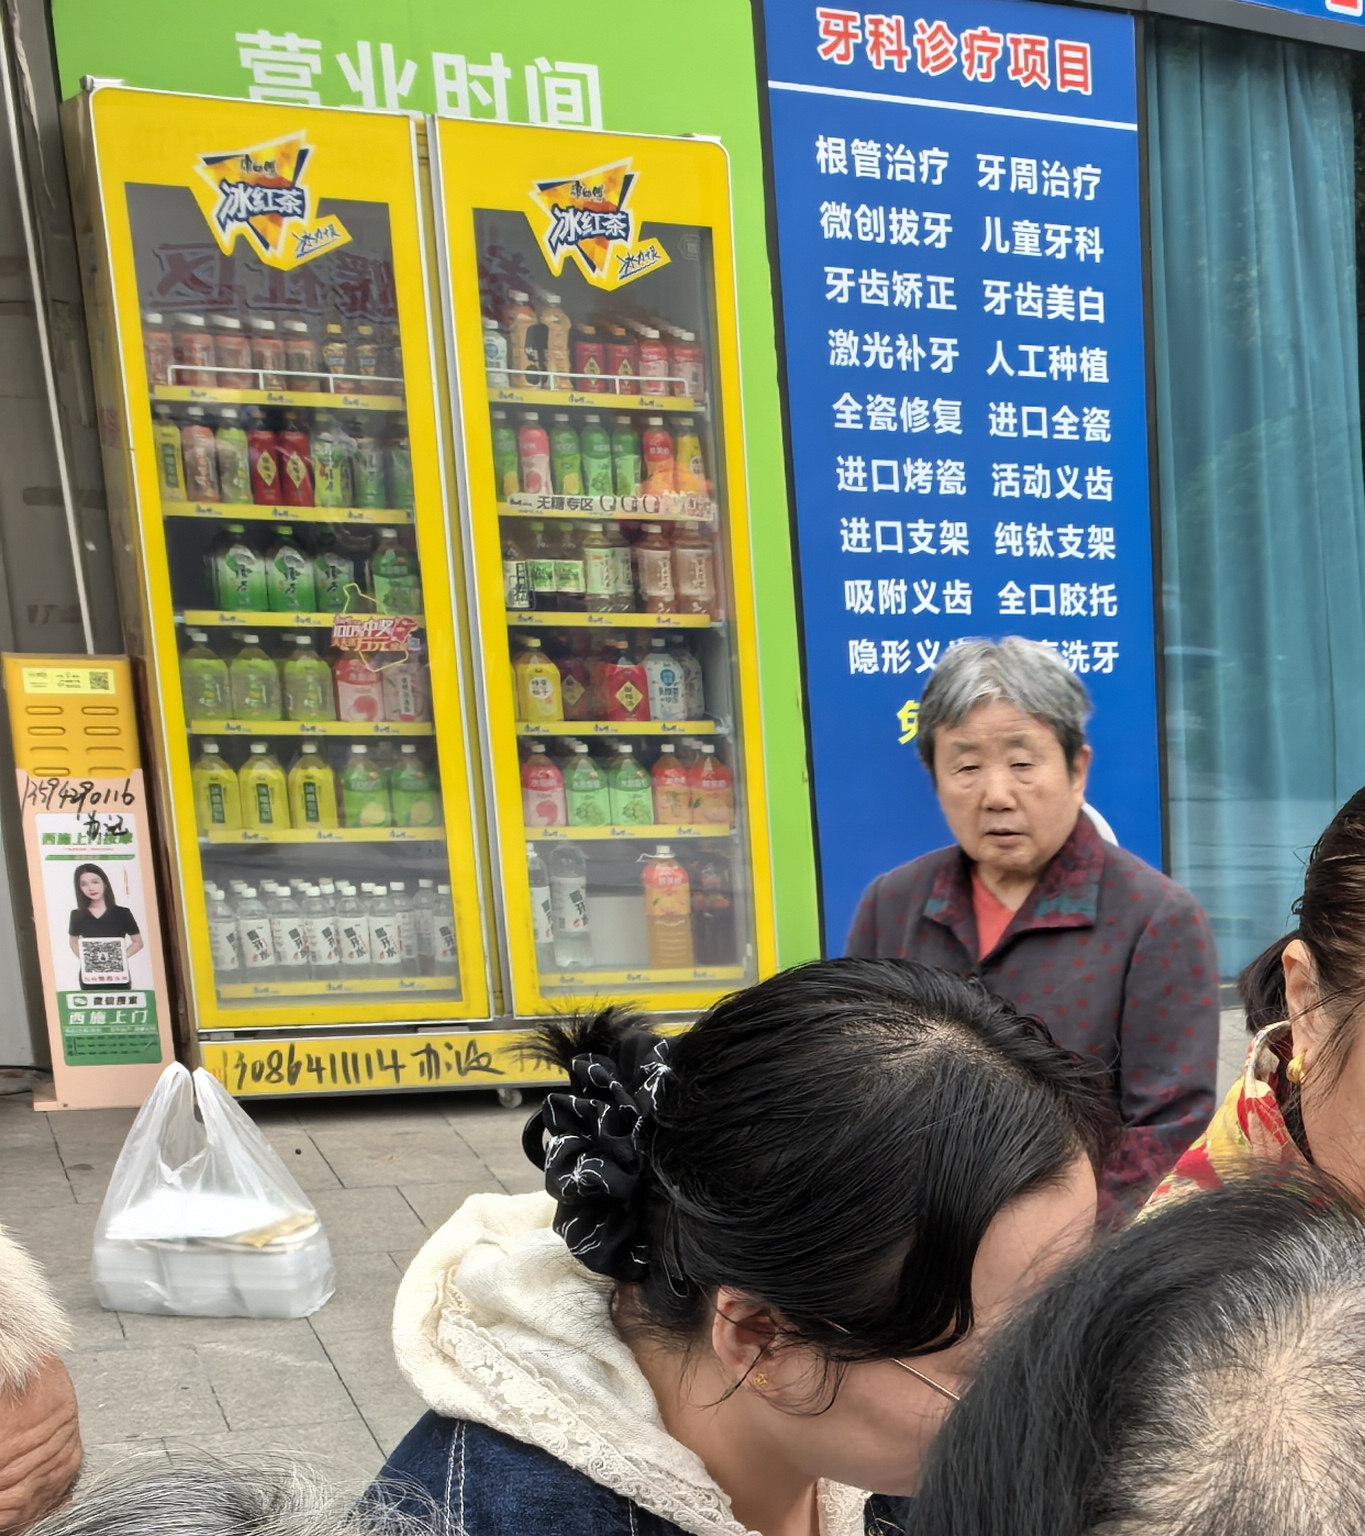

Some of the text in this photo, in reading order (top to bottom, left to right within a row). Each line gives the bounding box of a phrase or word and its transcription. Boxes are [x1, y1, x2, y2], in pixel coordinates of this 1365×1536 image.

[816, 9, 1094, 95] 牙科诊疗项目
[236, 30, 603, 130] 营业时间
[816, 135, 1102, 201] 根管治疗 牙周治疗
[219, 180, 303, 223] 冰红茶
[550, 206, 627, 247] 冰红茶
[820, 201, 1104, 264] 微创拔牙 儿童牙科
[823, 267, 1105, 324] 牙齿矫正 牙齿美白
[828, 330, 1109, 385] 激光补牙 人工种植
[832, 393, 1112, 443] 全瓷修复 进口全瓷
[836, 456, 1114, 502] 进口烤瓷 活动义齿
[537, 496, 594, 511] 无糖专区
[840, 519, 1117, 561] 进口支架 纯钛支架
[845, 579, 1118, 618] 吸附义齿 全口胶托
[849, 636, 968, 675] 隐形义
[68, 1009, 149, 1025] 西施上门
